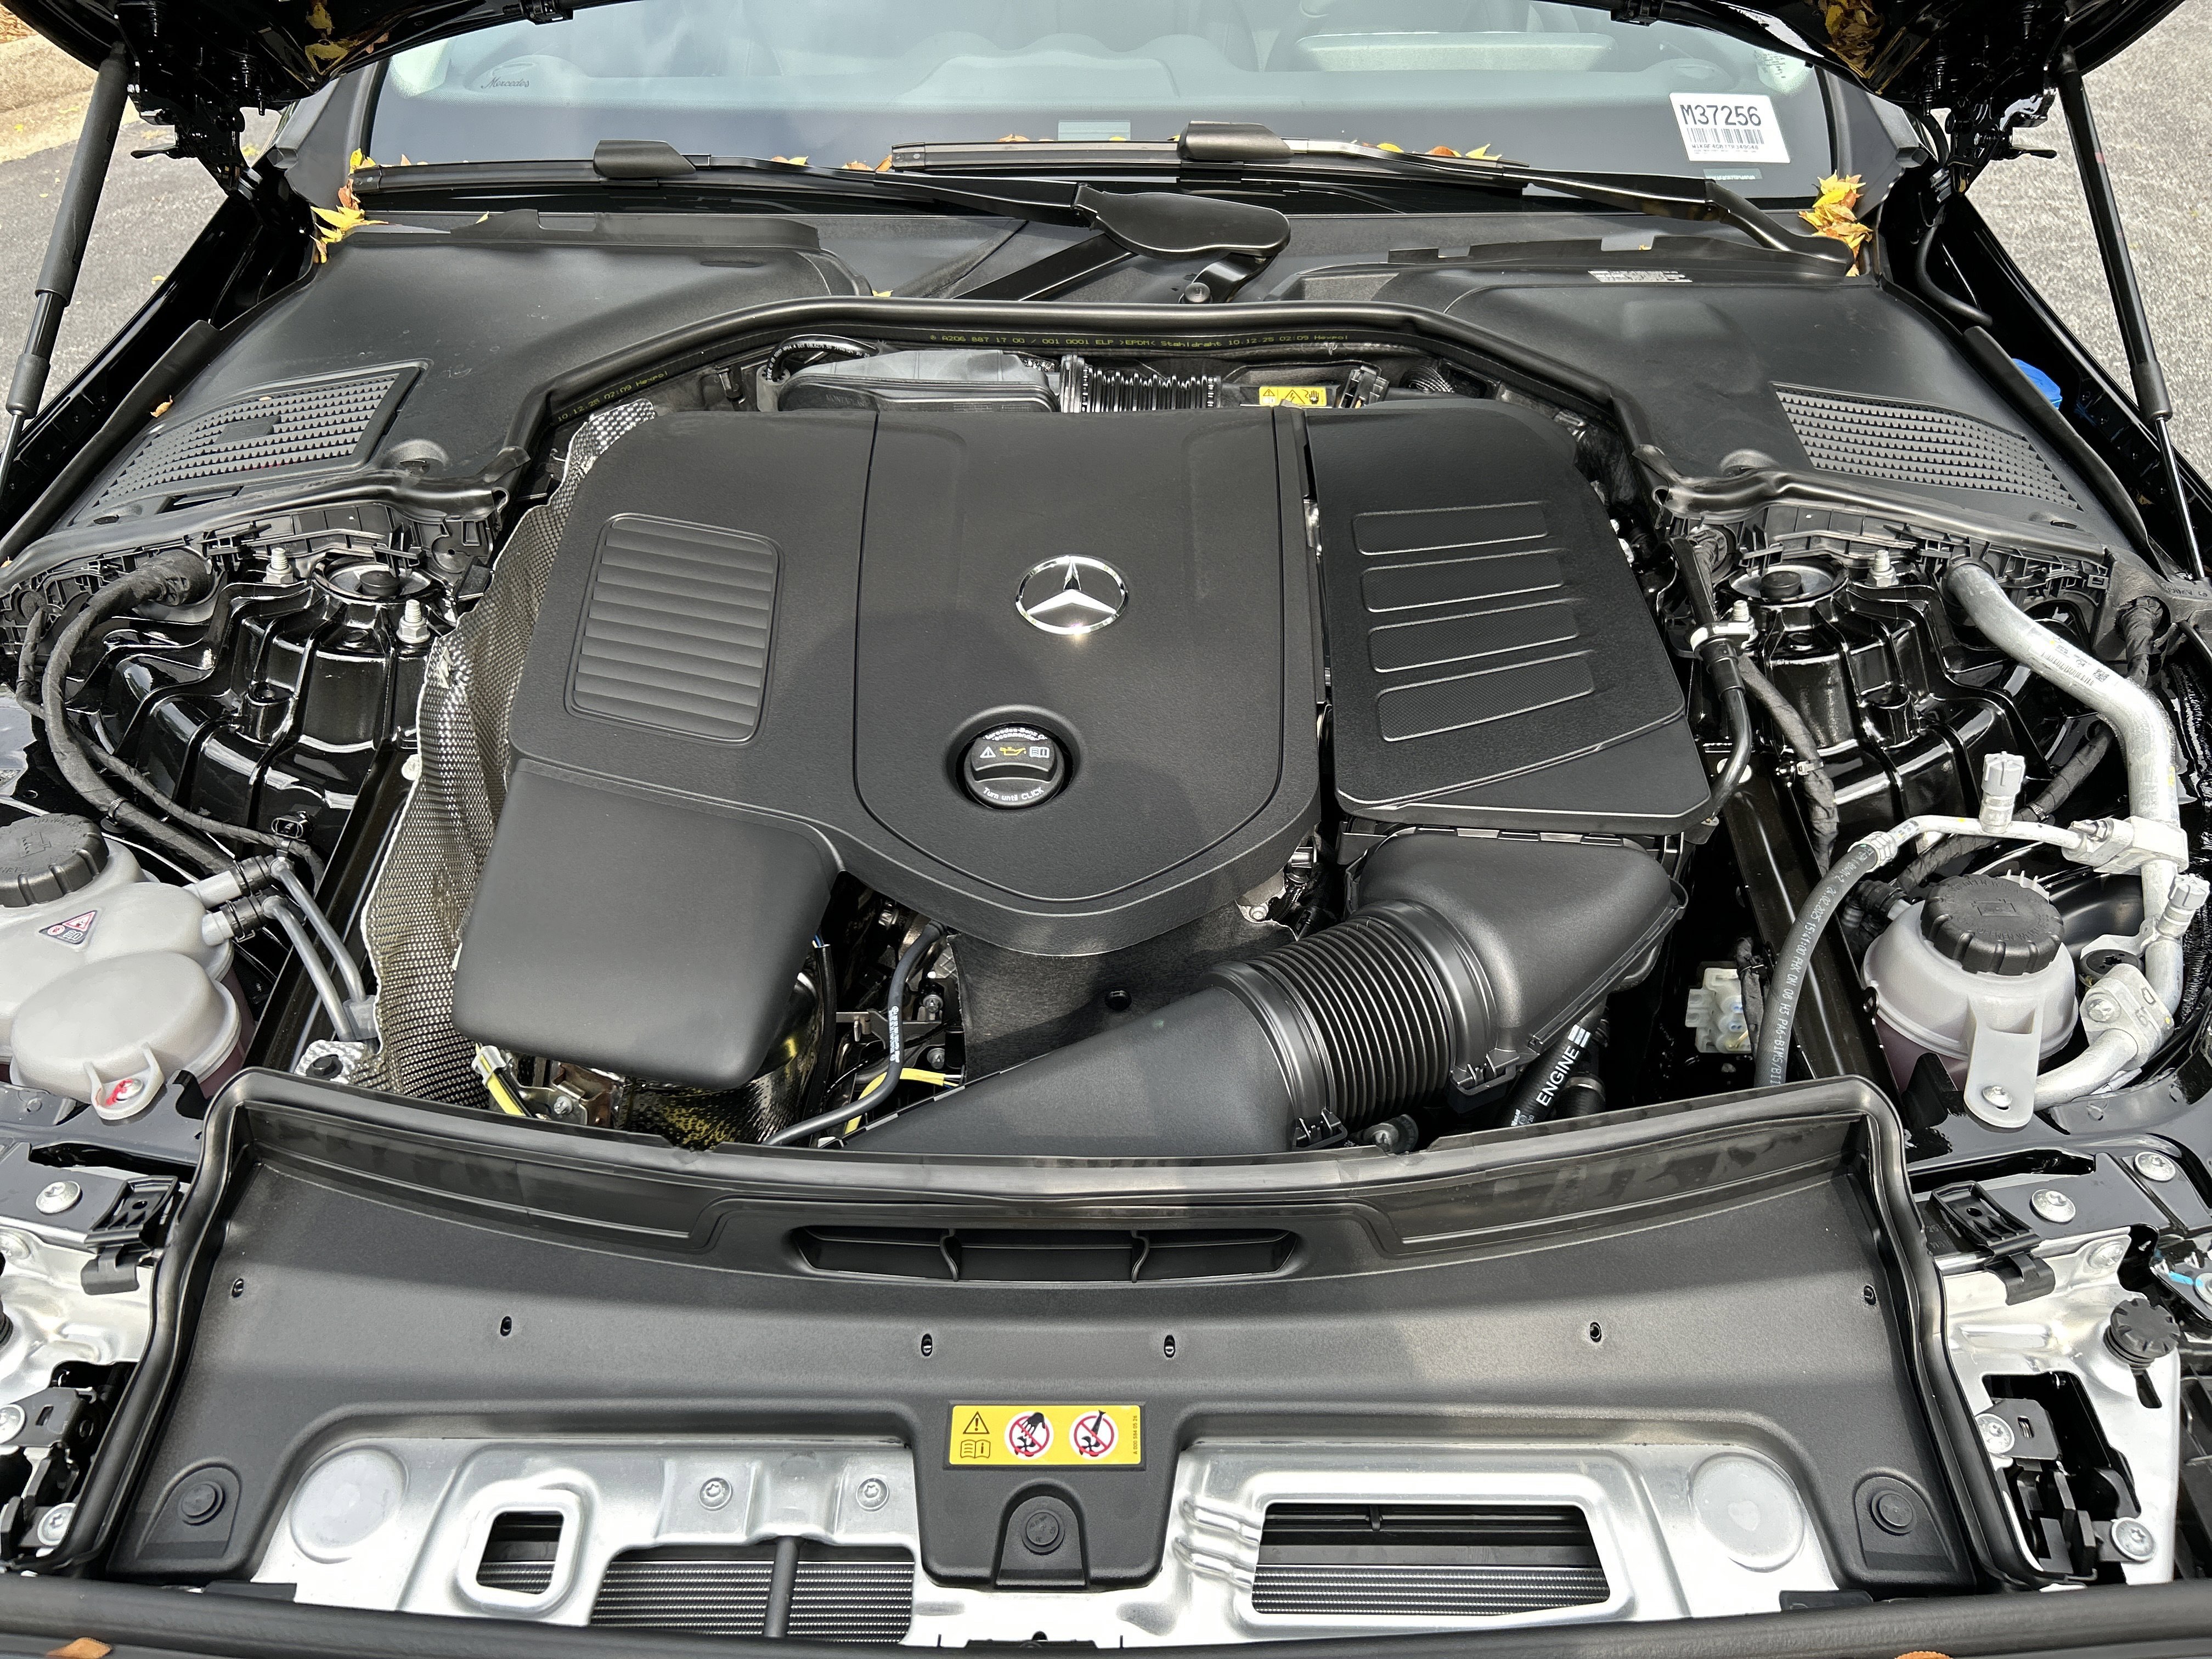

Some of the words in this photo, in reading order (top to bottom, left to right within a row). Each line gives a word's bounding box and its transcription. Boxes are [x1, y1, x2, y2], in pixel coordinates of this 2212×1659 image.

[481, 76, 529, 88] Mercedes
[1679, 104, 1762, 126] M37256
[1228, 336, 1274, 346] 10.12.25
[557, 398, 601, 422] 10.12.25
[635, 370, 668, 387] Hexpol
[983, 787, 1000, 800] Turn
[1021, 787, 1045, 800] CLICK
[1779, 1002, 1791, 1016] H3
[1536, 1045, 1579, 1107] ENGINE
